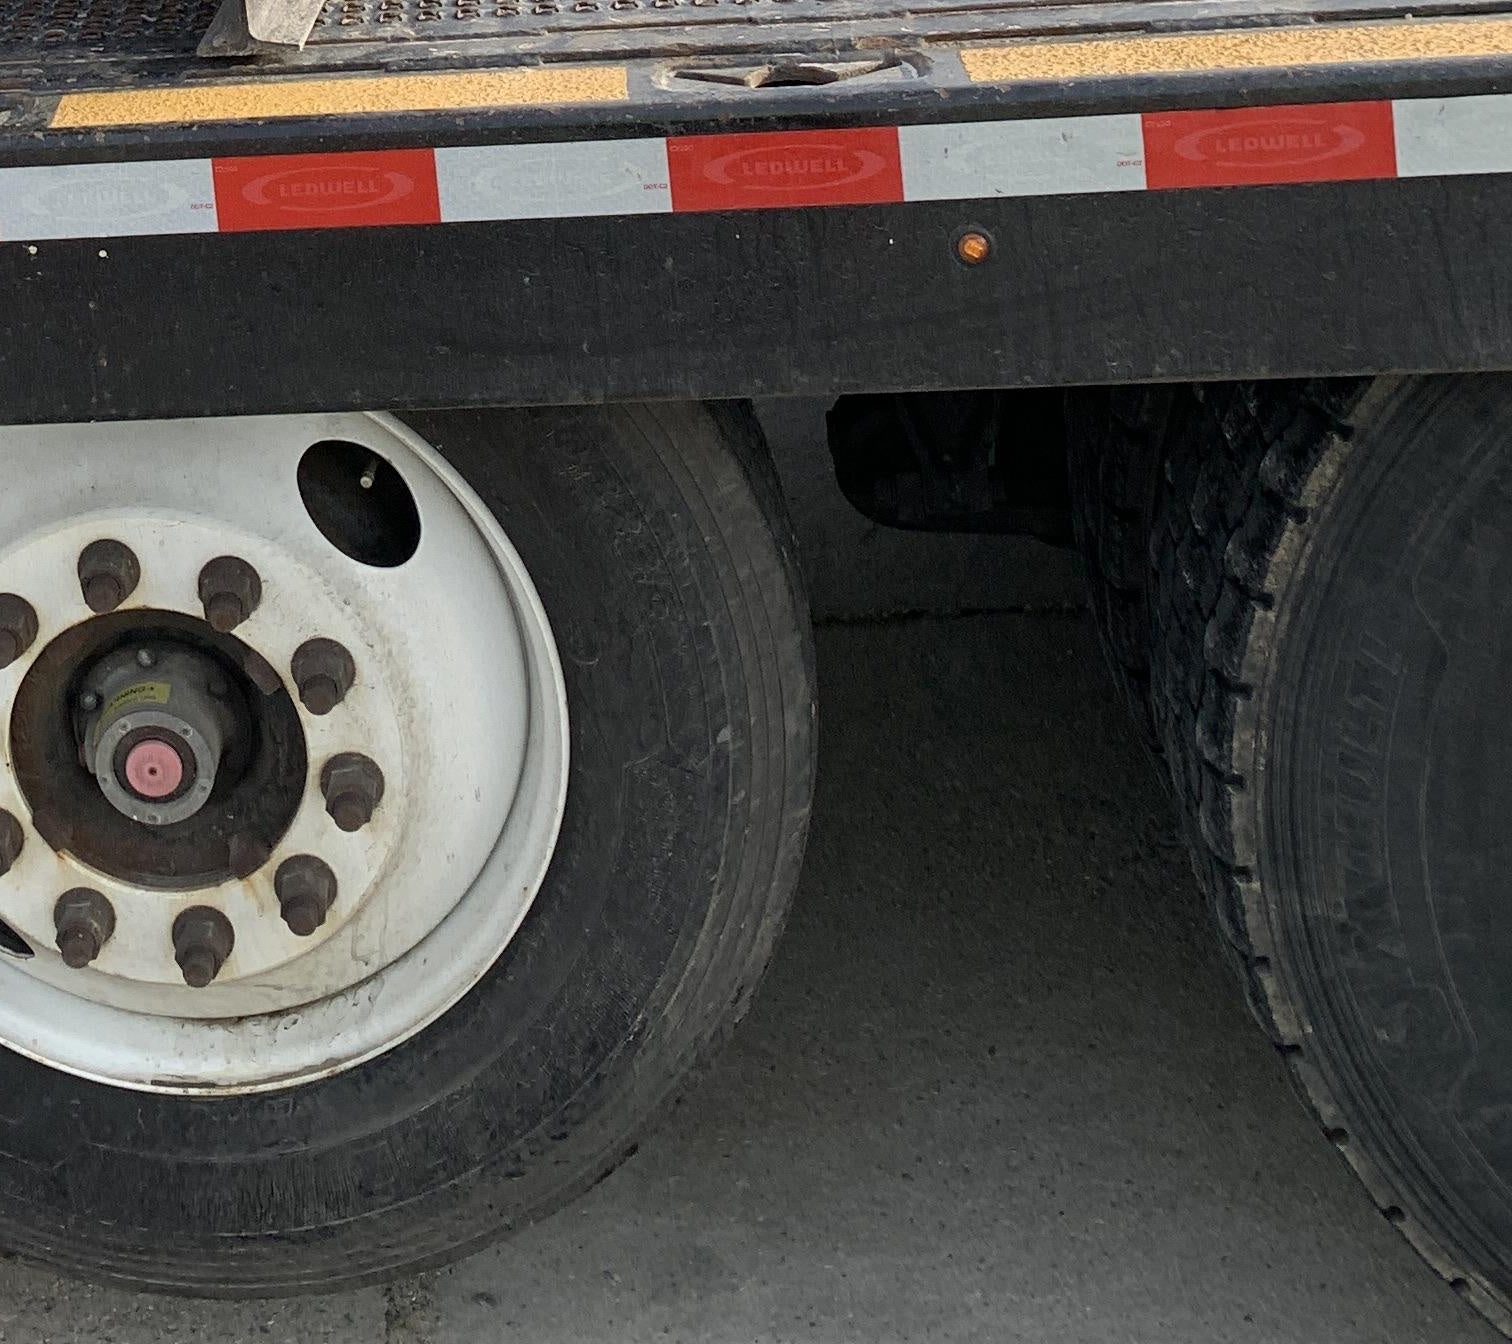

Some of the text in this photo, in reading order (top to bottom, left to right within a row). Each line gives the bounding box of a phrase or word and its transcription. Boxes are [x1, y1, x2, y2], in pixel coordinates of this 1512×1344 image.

[1216, 133, 1328, 153] LEDWELL
[743, 158, 849, 176] LEDWELL
[279, 179, 378, 197] LEDWELL
